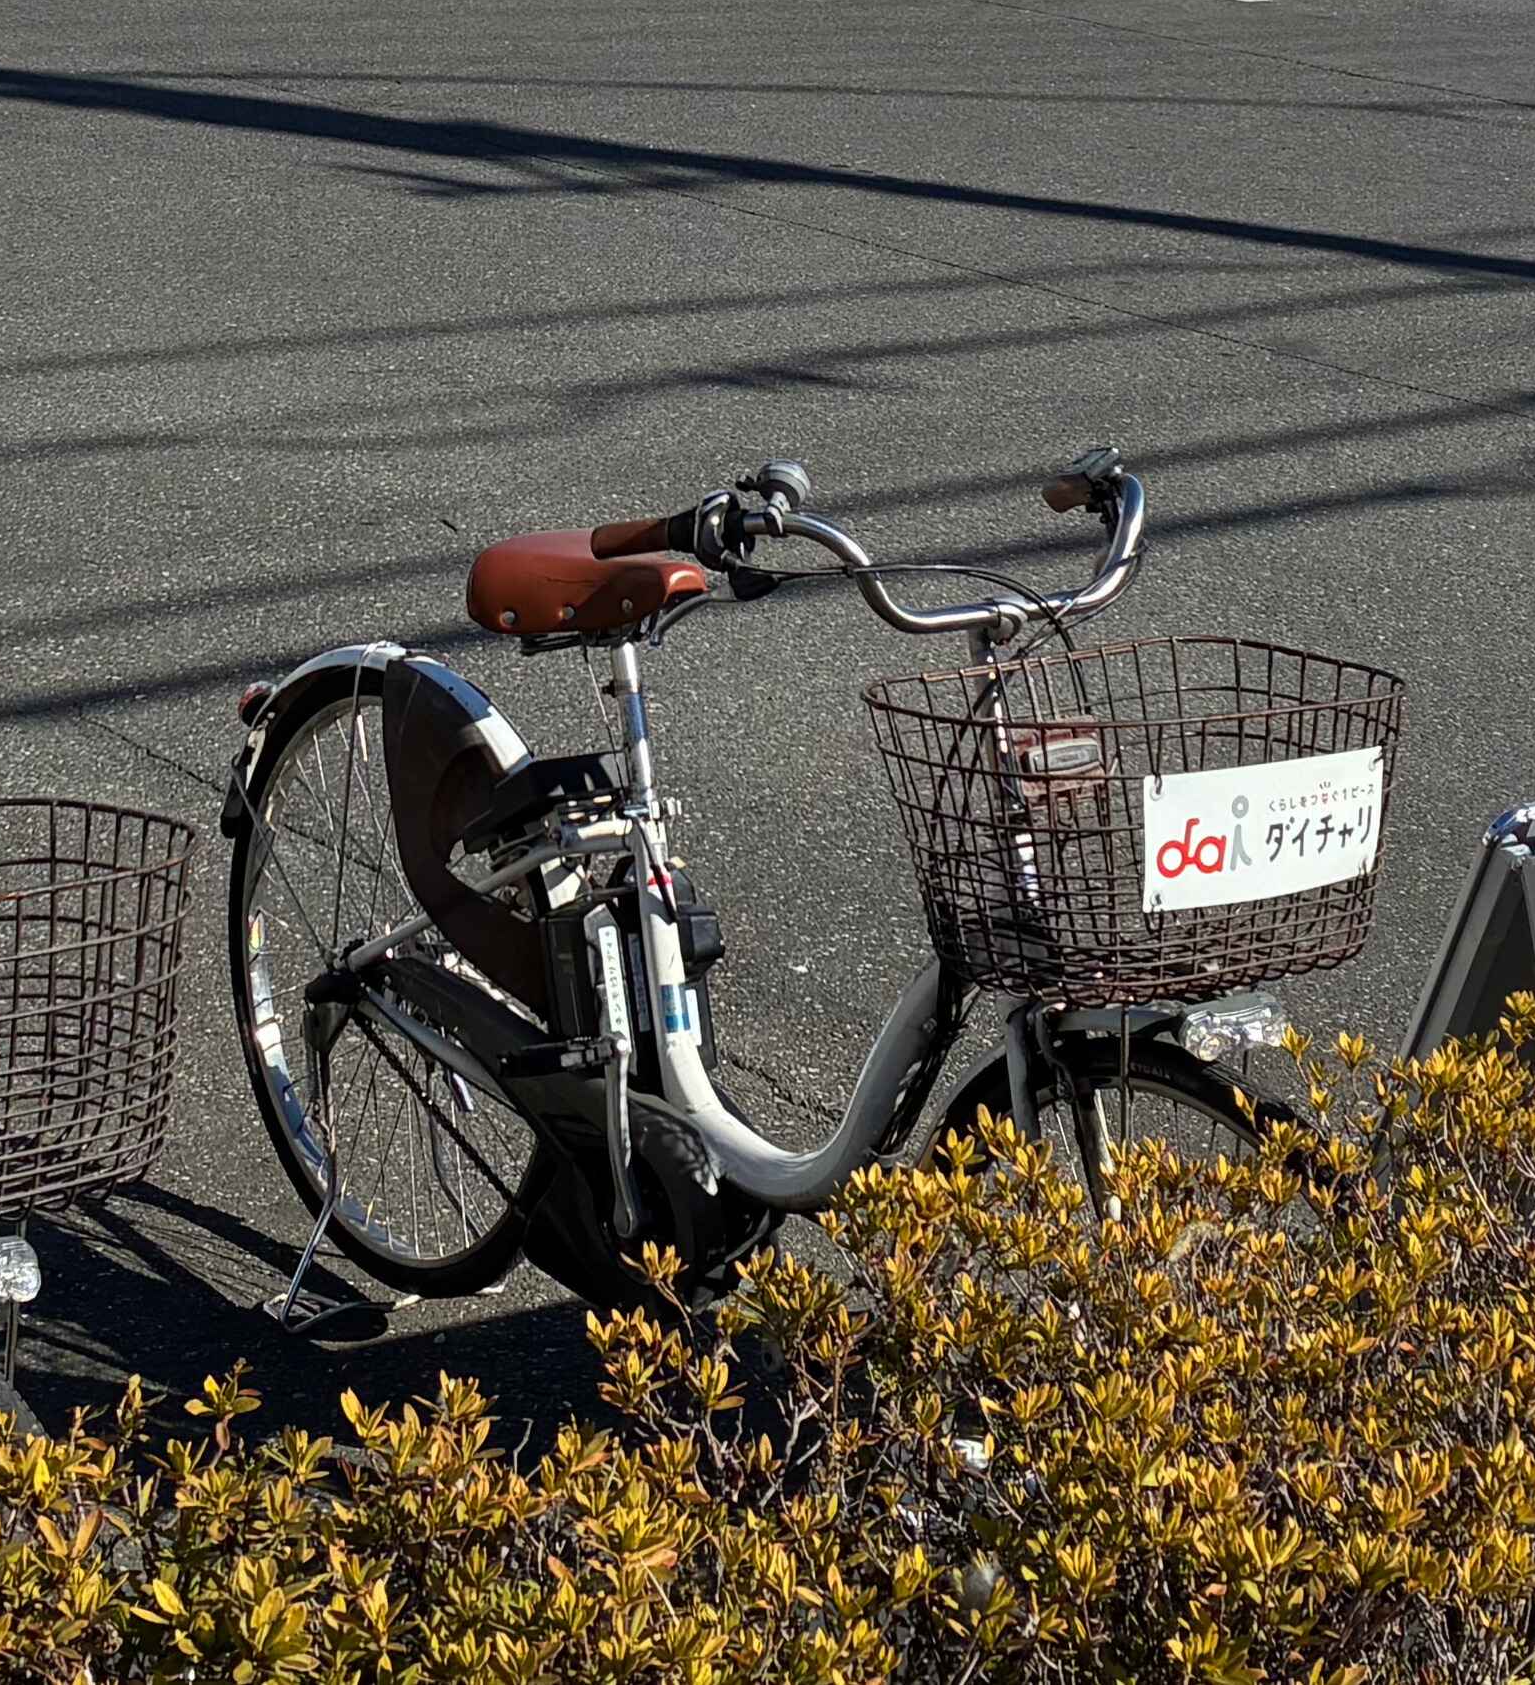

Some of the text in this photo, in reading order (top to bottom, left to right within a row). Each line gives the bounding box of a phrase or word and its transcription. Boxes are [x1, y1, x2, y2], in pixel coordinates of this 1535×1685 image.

[1265, 804, 1373, 863] ダイチャリ
